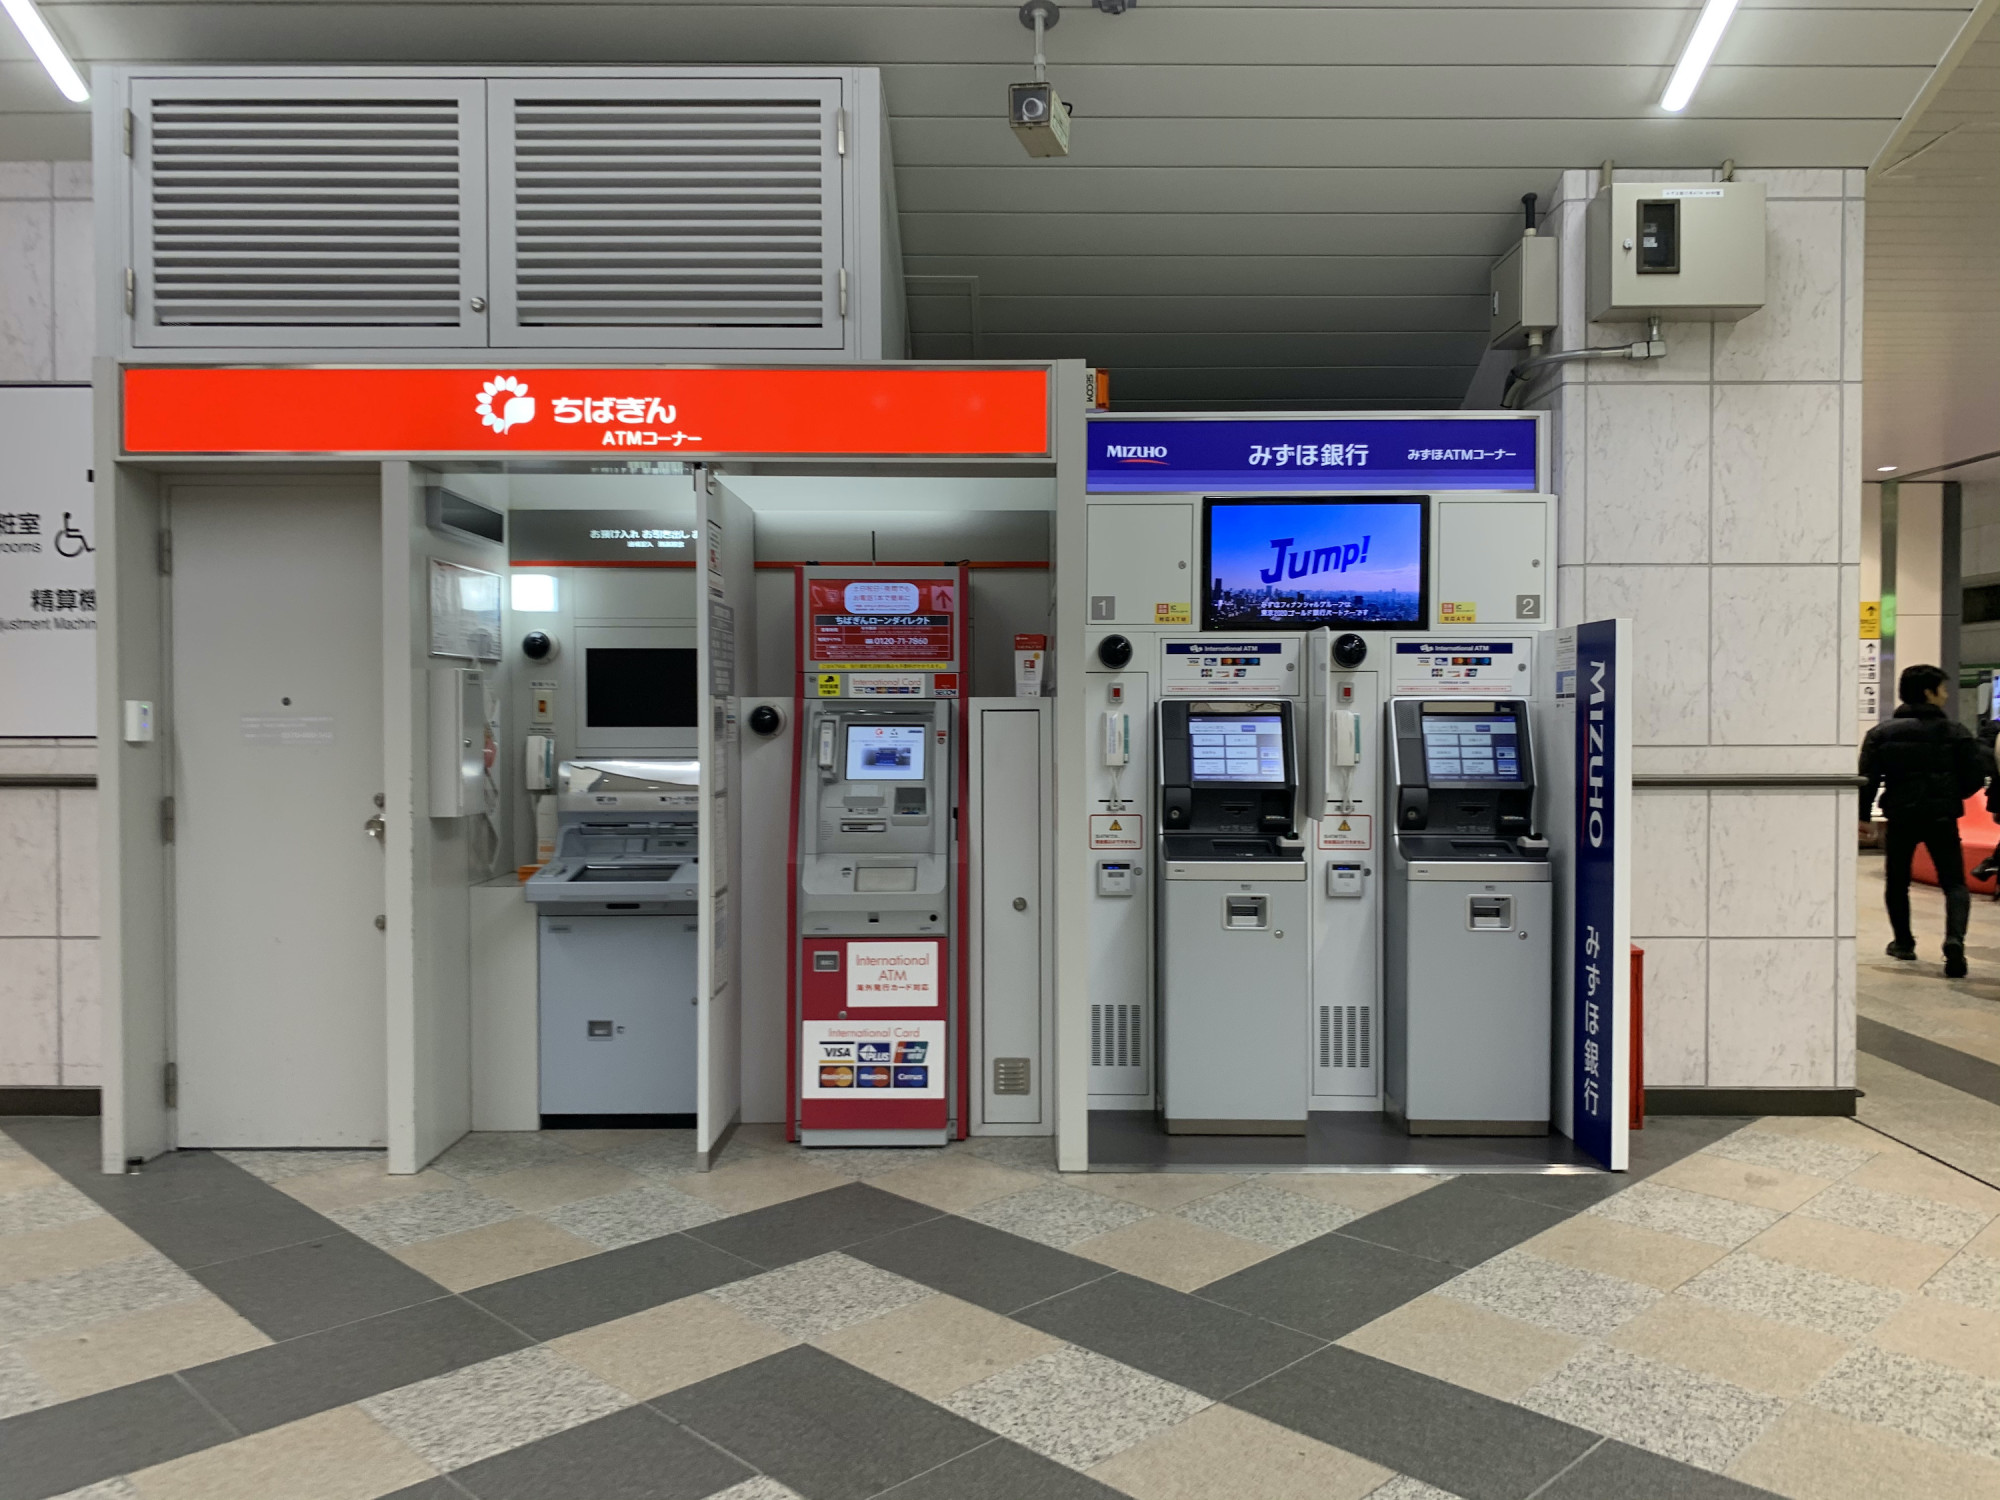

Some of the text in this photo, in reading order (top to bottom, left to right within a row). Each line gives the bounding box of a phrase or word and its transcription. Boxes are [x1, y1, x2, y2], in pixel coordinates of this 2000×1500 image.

[1086, 374, 1094, 402] SECOM
[551, 397, 676, 424] ちばぎん
[601, 430, 702, 447] ATMコーナー
[1106, 445, 1168, 458] MIZUHO
[1248, 444, 1369, 467] みずほ銀行
[1407, 448, 1517, 461] みずほATMコーナー
[1260, 535, 1371, 584] Jump!
[1097, 602, 1107, 616] 1
[1522, 598, 1535, 615] 2
[835, 616, 931, 625] ちばぎんローンダイレクト
[1589, 660, 1606, 848] MIZUHO
[856, 953, 930, 966] International
[878, 969, 907, 981] ATM
[1584, 925, 1601, 1117] みずほ銀行
[828, 1028, 920, 1038] International Card
[823, 1047, 851, 1058] VISA
